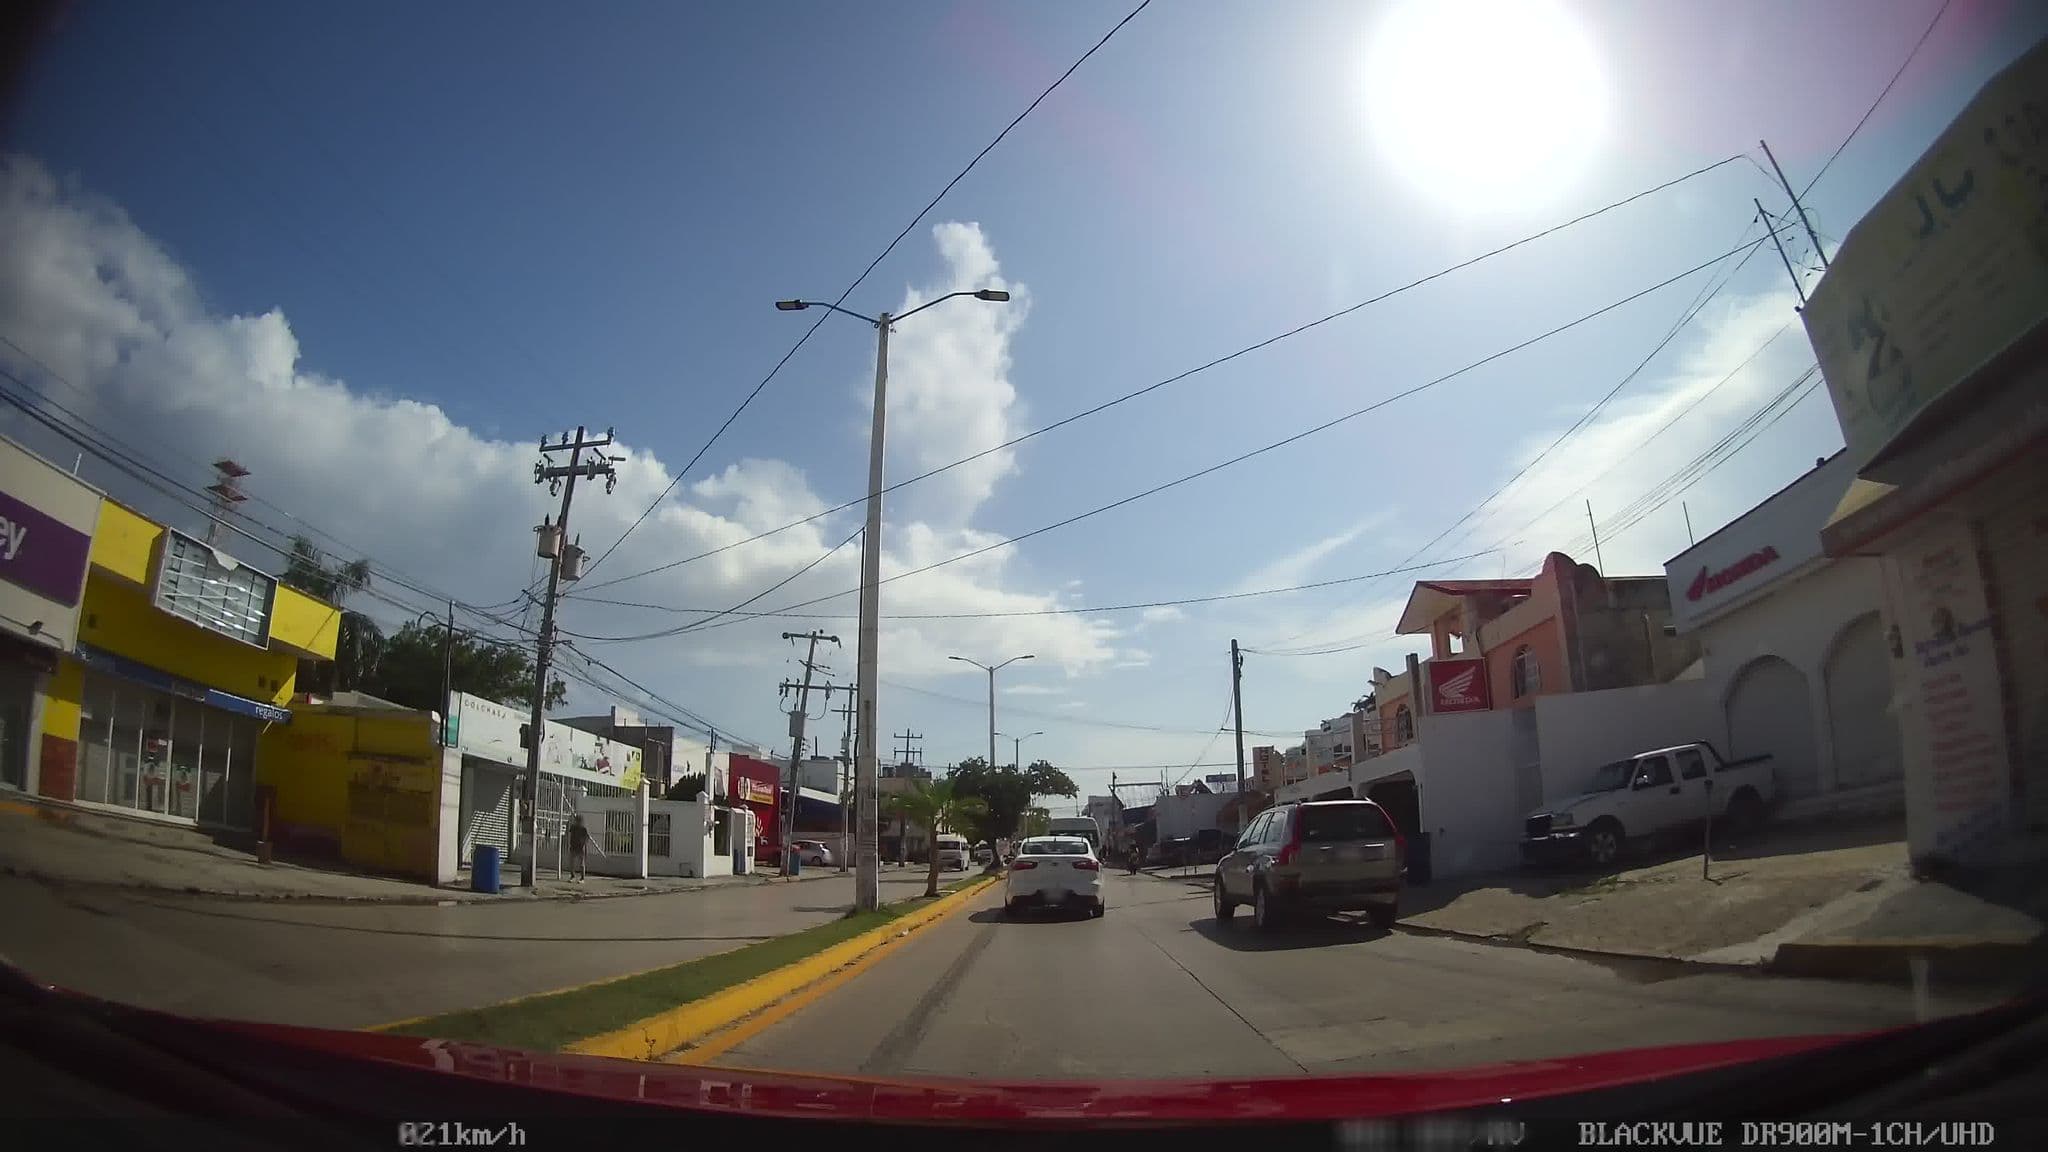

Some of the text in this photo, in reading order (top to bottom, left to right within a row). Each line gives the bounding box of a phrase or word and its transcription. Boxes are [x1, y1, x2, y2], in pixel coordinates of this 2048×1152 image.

[1706, 544, 1781, 594] HONDA
[1440, 696, 1480, 705] HONDA
[255, 706, 283, 720] regalos
